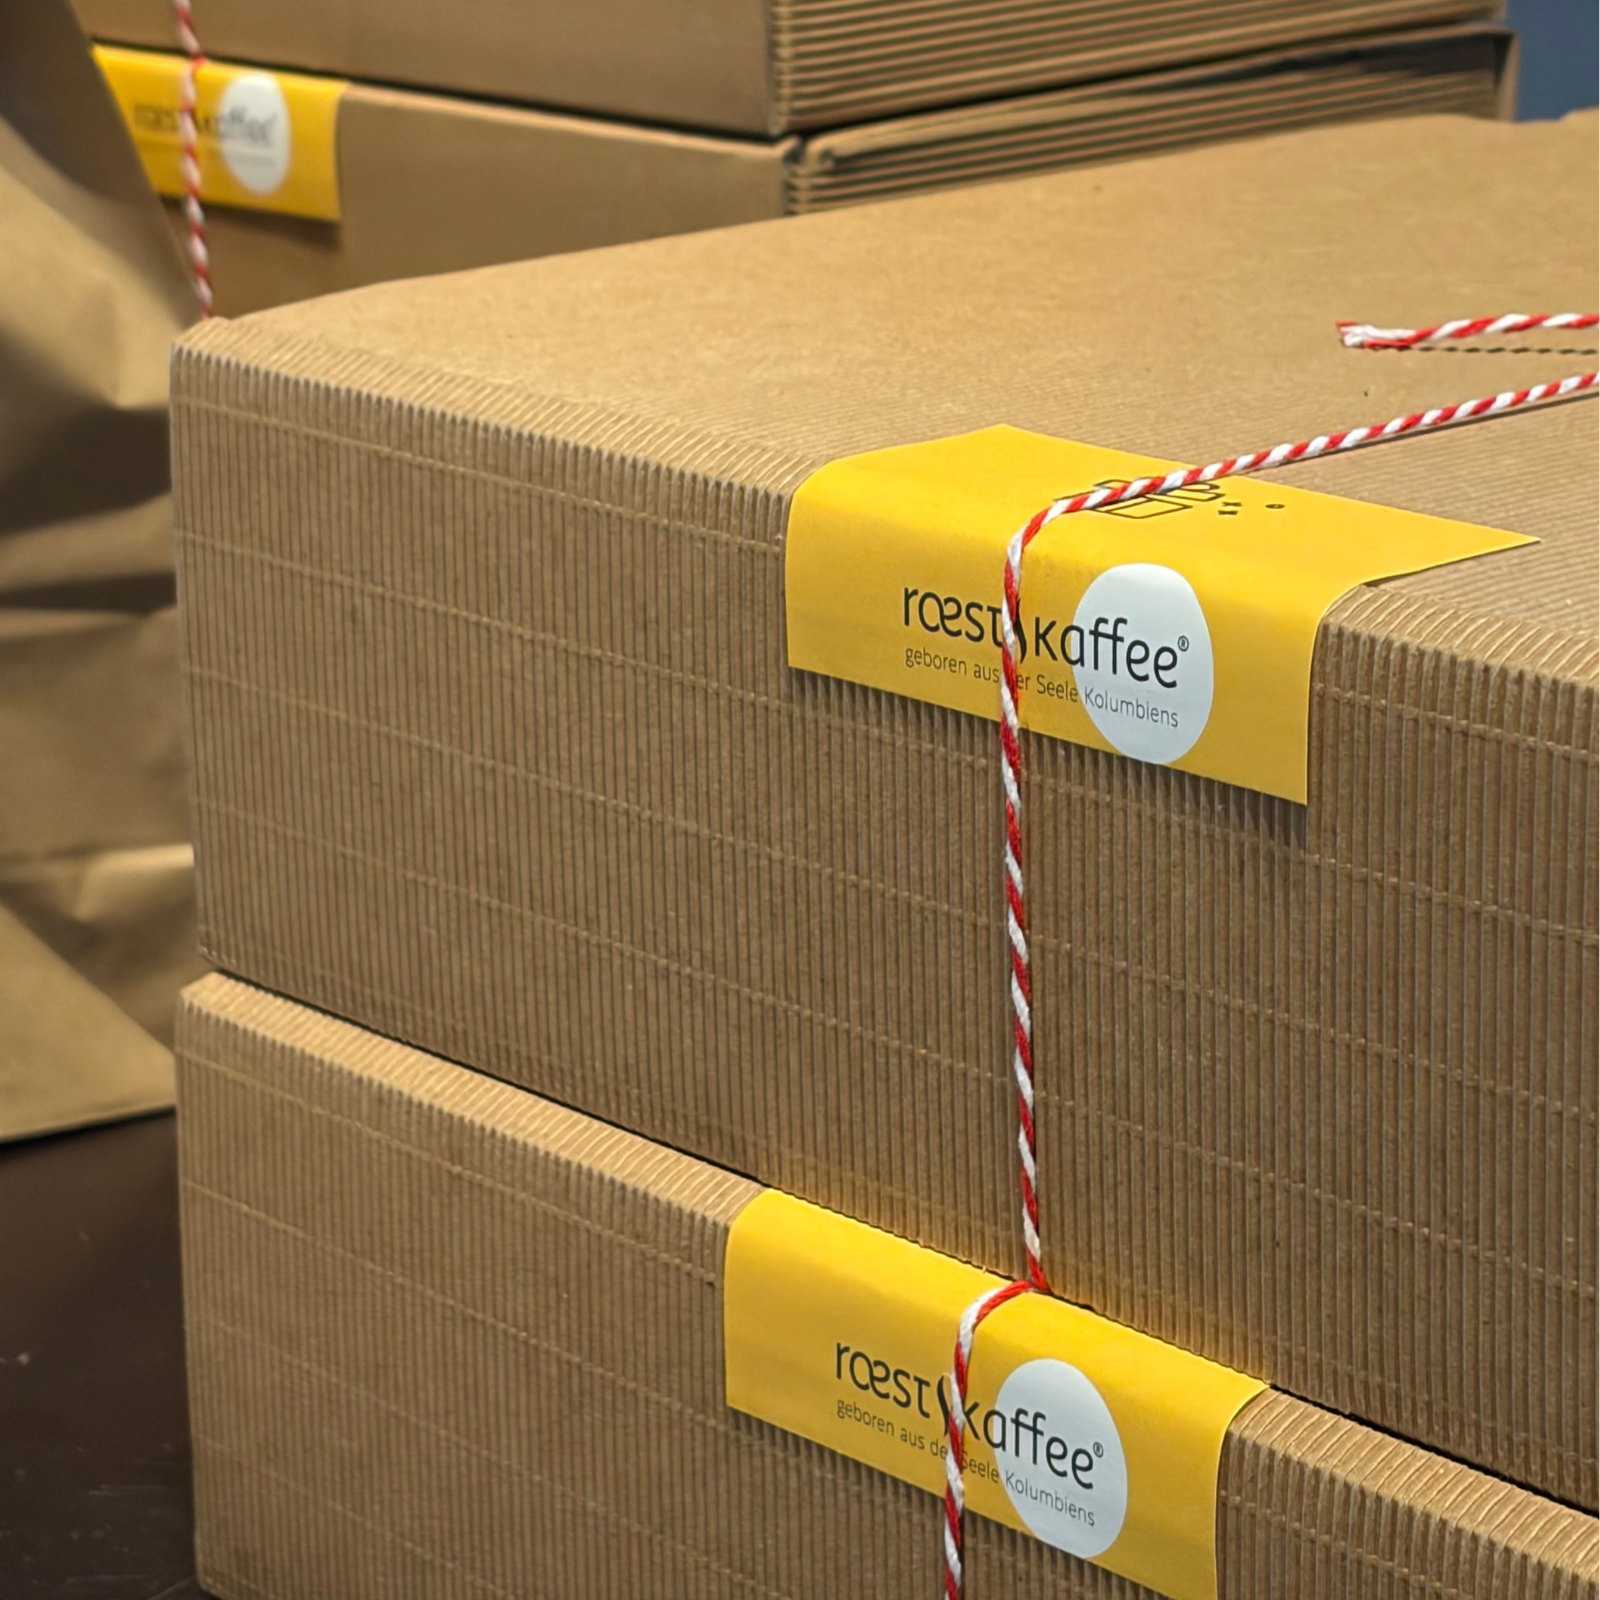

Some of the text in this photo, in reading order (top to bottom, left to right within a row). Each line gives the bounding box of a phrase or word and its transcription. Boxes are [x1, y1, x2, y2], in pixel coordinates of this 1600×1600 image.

[905, 646, 1179, 729] geboren aus er Seele Kolumbiens
[836, 1399, 895, 1437] geboren
[900, 1426, 925, 1450] aus
[930, 1438, 948, 1460] de
[1005, 1469, 1095, 1528] Kolumbiens
